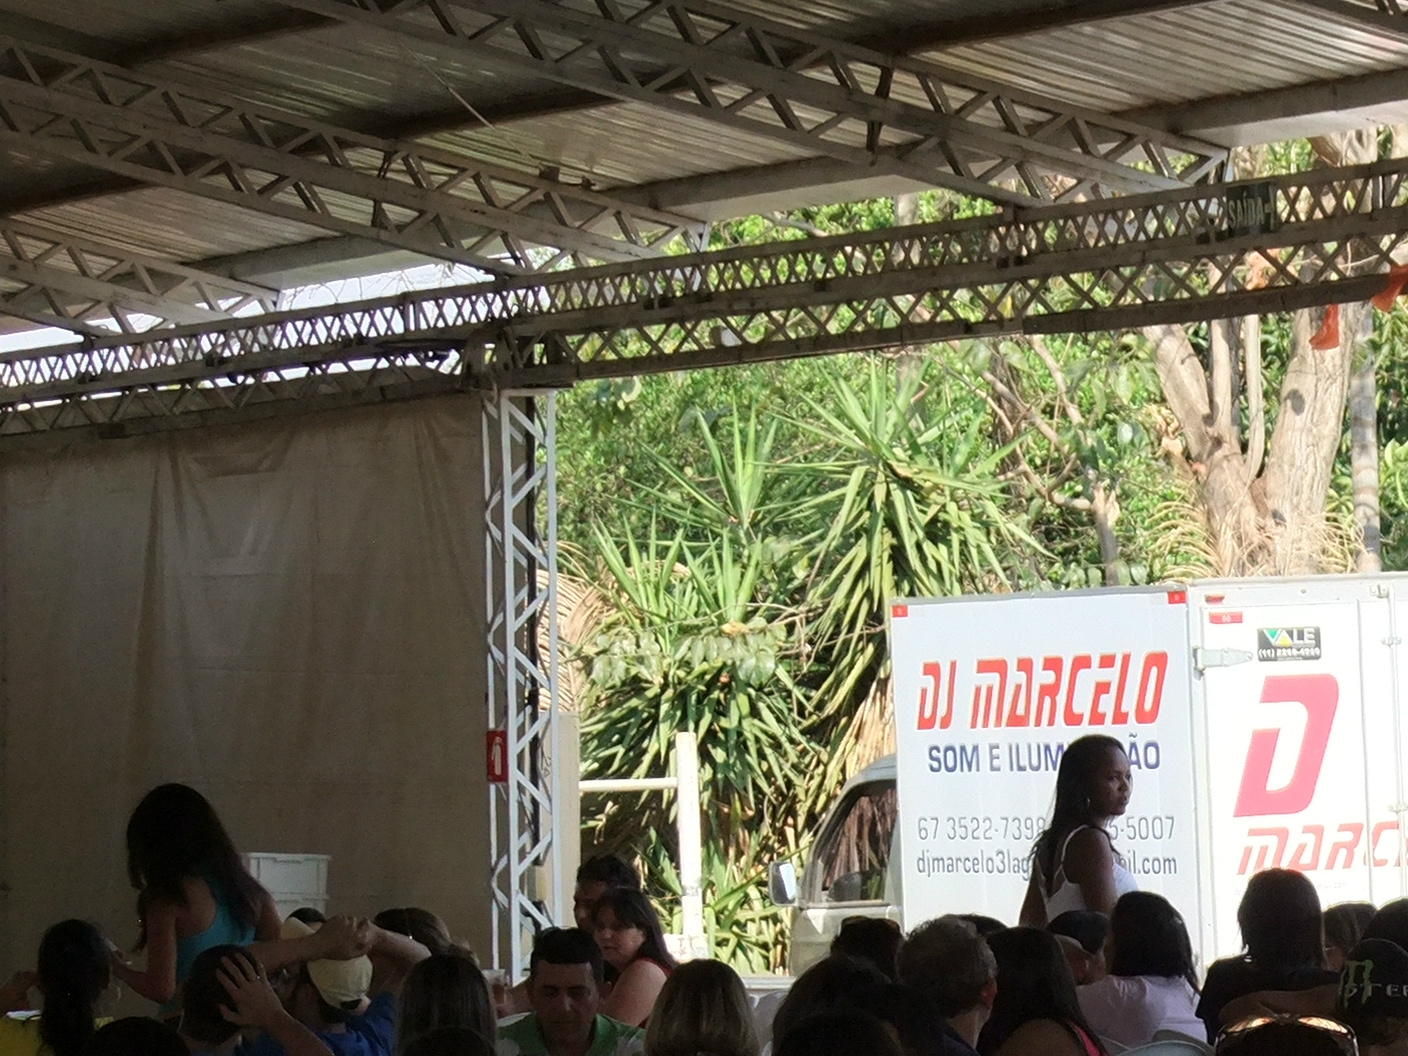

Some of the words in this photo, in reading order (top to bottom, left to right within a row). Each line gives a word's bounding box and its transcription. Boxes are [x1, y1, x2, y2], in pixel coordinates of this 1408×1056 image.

[1262, 627, 1316, 647] VALE
[916, 659, 957, 731] DJ
[970, 650, 1169, 729] MARCELO
[928, 743, 980, 773] SOM
[989, 743, 1000, 772] E
[1008, 732, 1161, 772] ILUMÃO
[1233, 673, 1340, 818] D
[917, 817, 939, 840] 67
